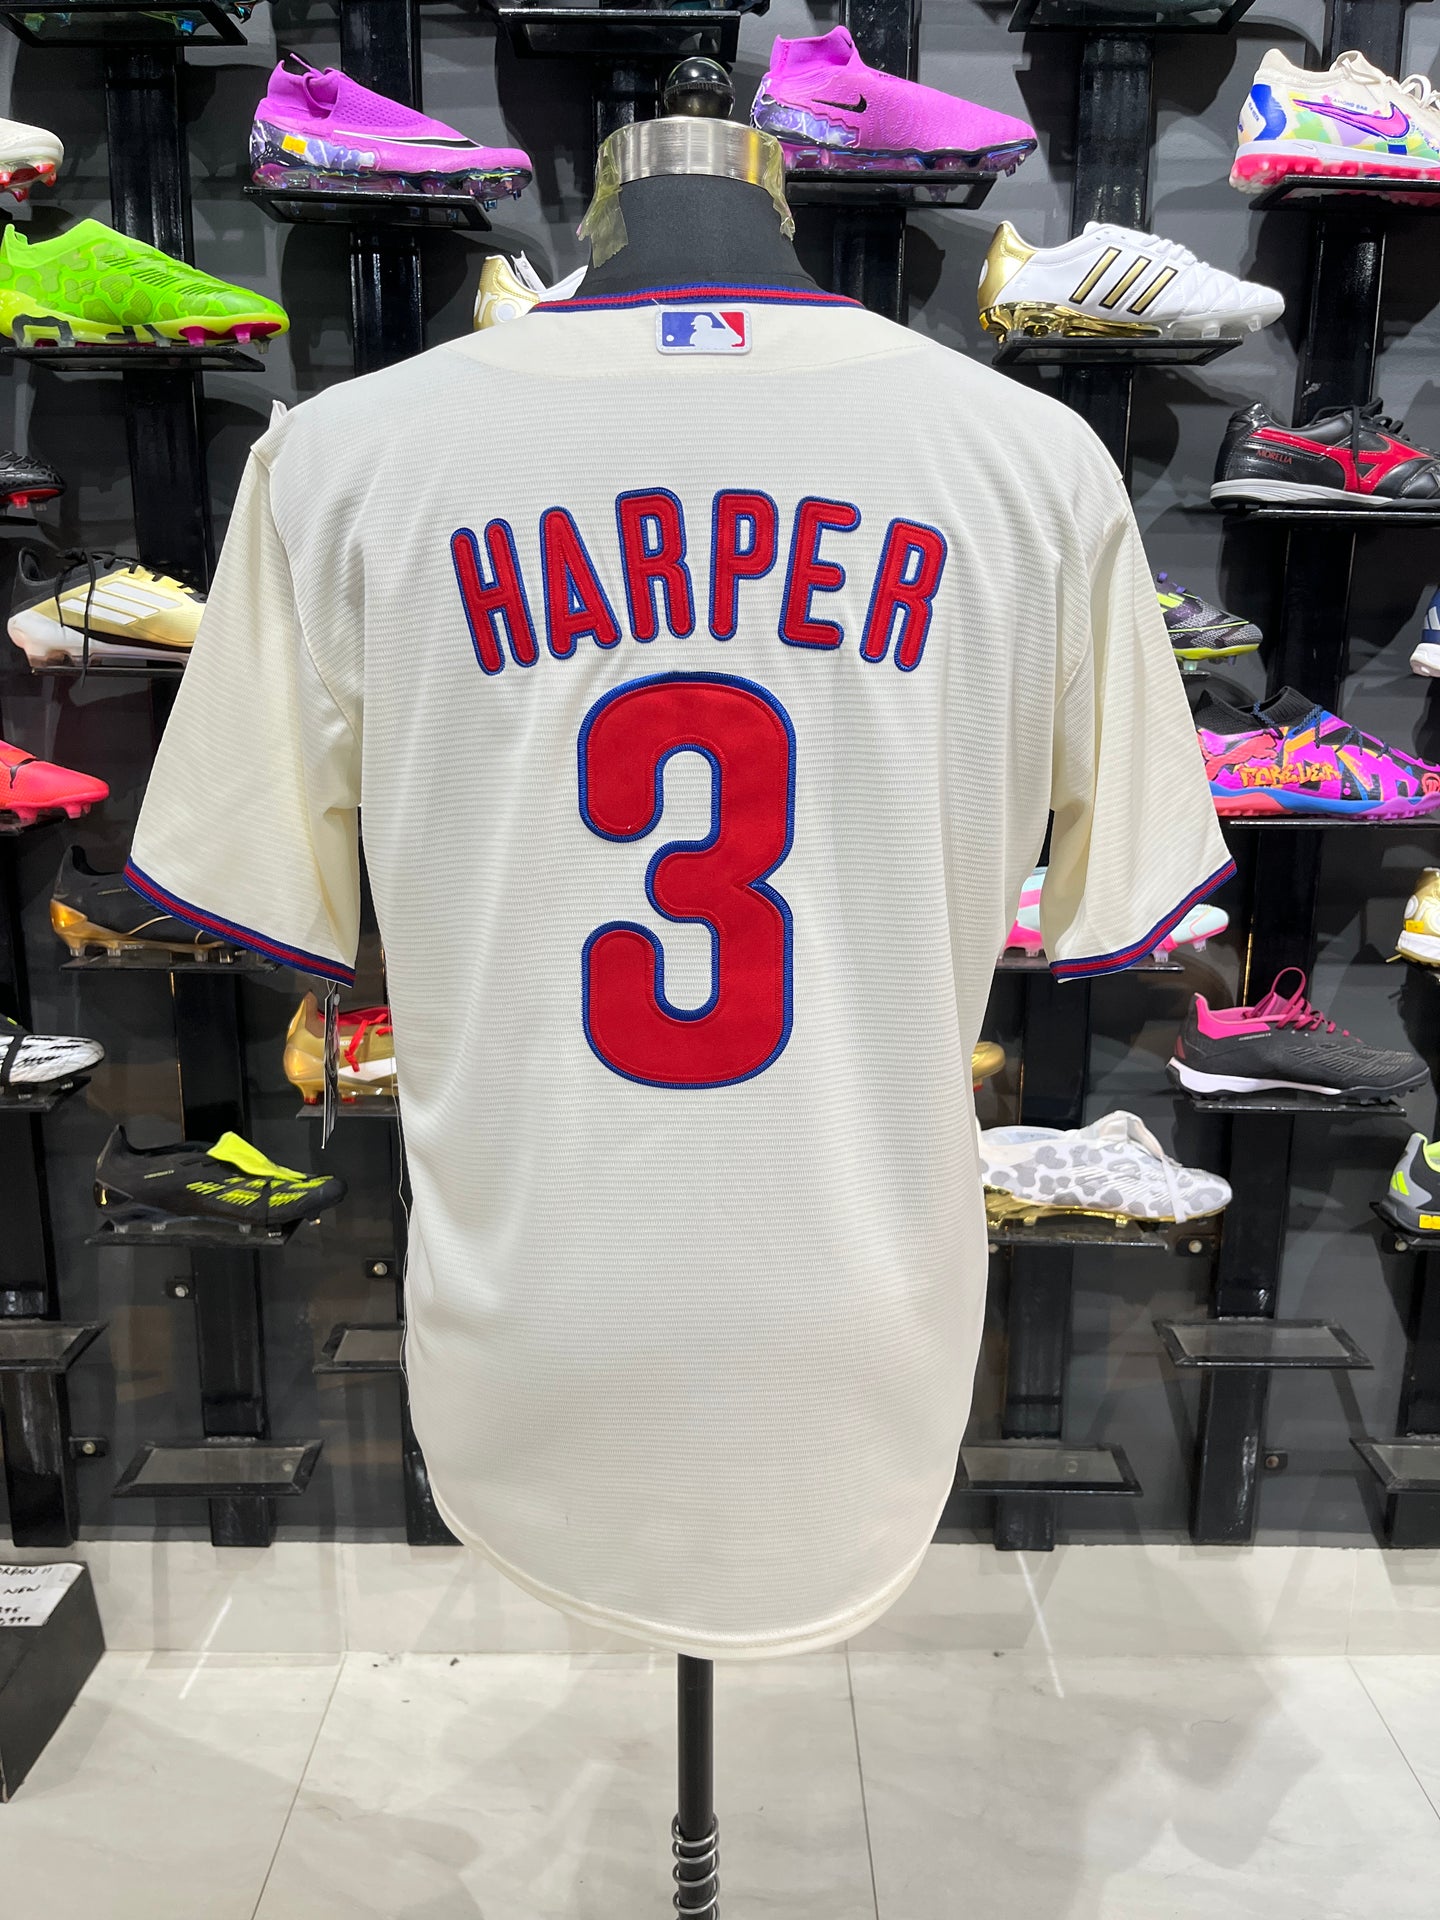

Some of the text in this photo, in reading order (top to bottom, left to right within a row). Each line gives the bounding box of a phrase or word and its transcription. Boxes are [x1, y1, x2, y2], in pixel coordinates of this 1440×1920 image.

[1255, 449, 1293, 464] MORELIA
[450, 487, 948, 676] HARPER
[1239, 762, 1342, 787] FOREVER
[577, 671, 796, 1089] 3
